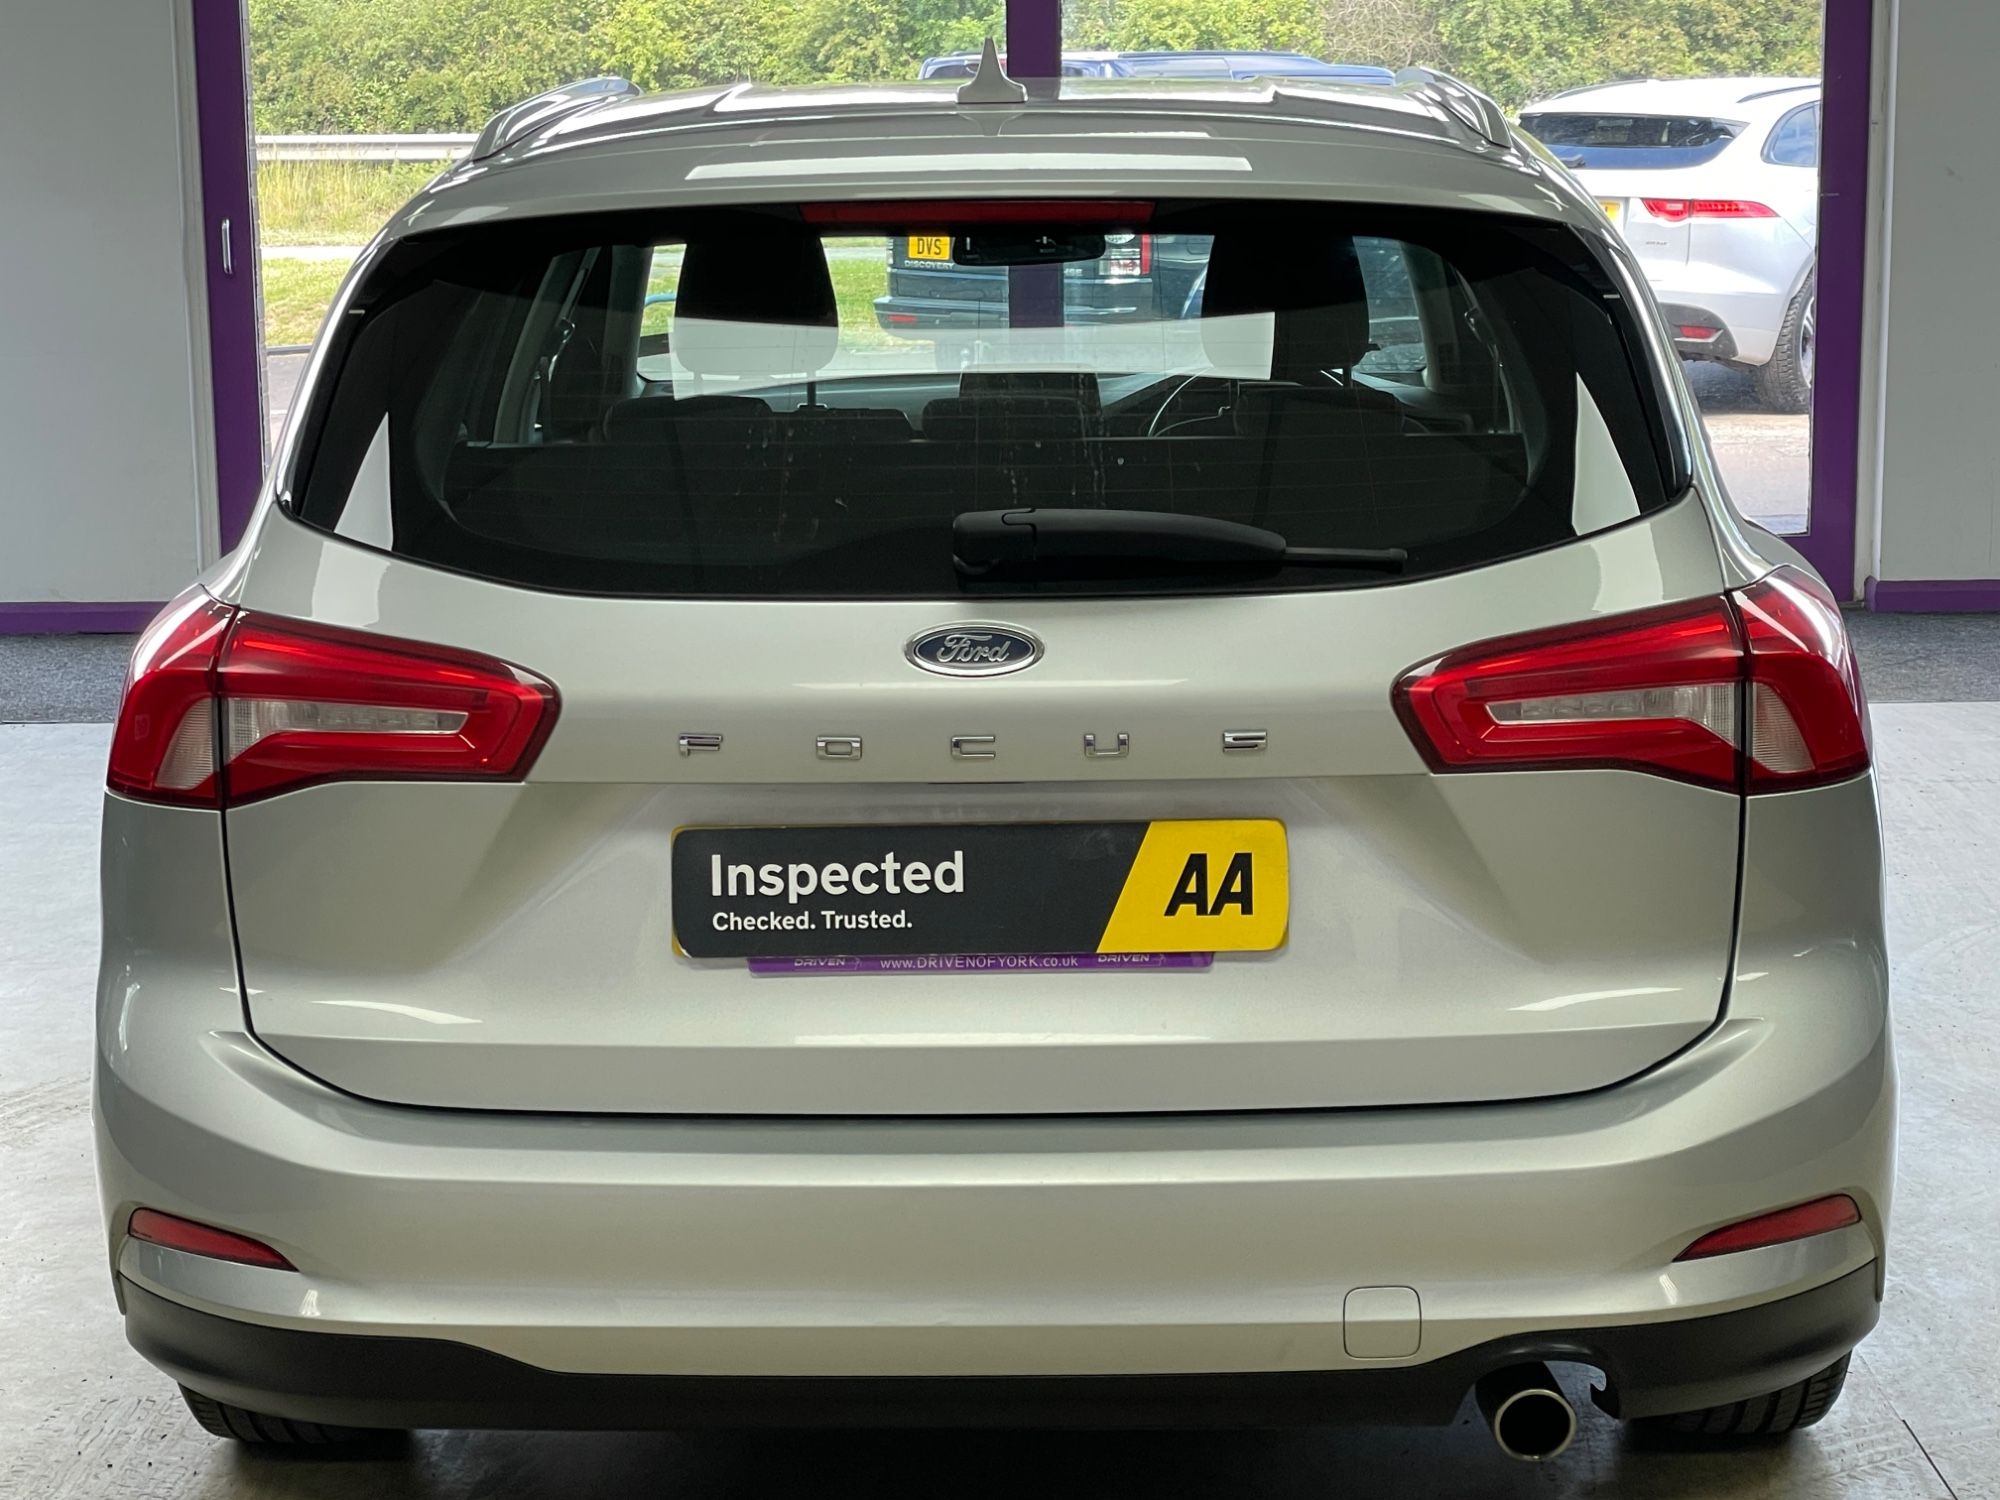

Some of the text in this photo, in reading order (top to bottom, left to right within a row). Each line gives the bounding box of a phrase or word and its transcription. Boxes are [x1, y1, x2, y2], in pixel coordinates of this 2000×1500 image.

[917, 237, 942, 255] DVS
[936, 634, 1011, 662] Ford
[678, 729, 1267, 760] FOCUS
[711, 850, 965, 904] Inspected
[1164, 852, 1254, 917] AA
[712, 909, 913, 931] Checked. Trusted.
[794, 957, 846, 967] DRIVEN
[880, 955, 1079, 969] www.DRIVENOFYORK.co.uk
[1097, 953, 1151, 963] DRIVEN
